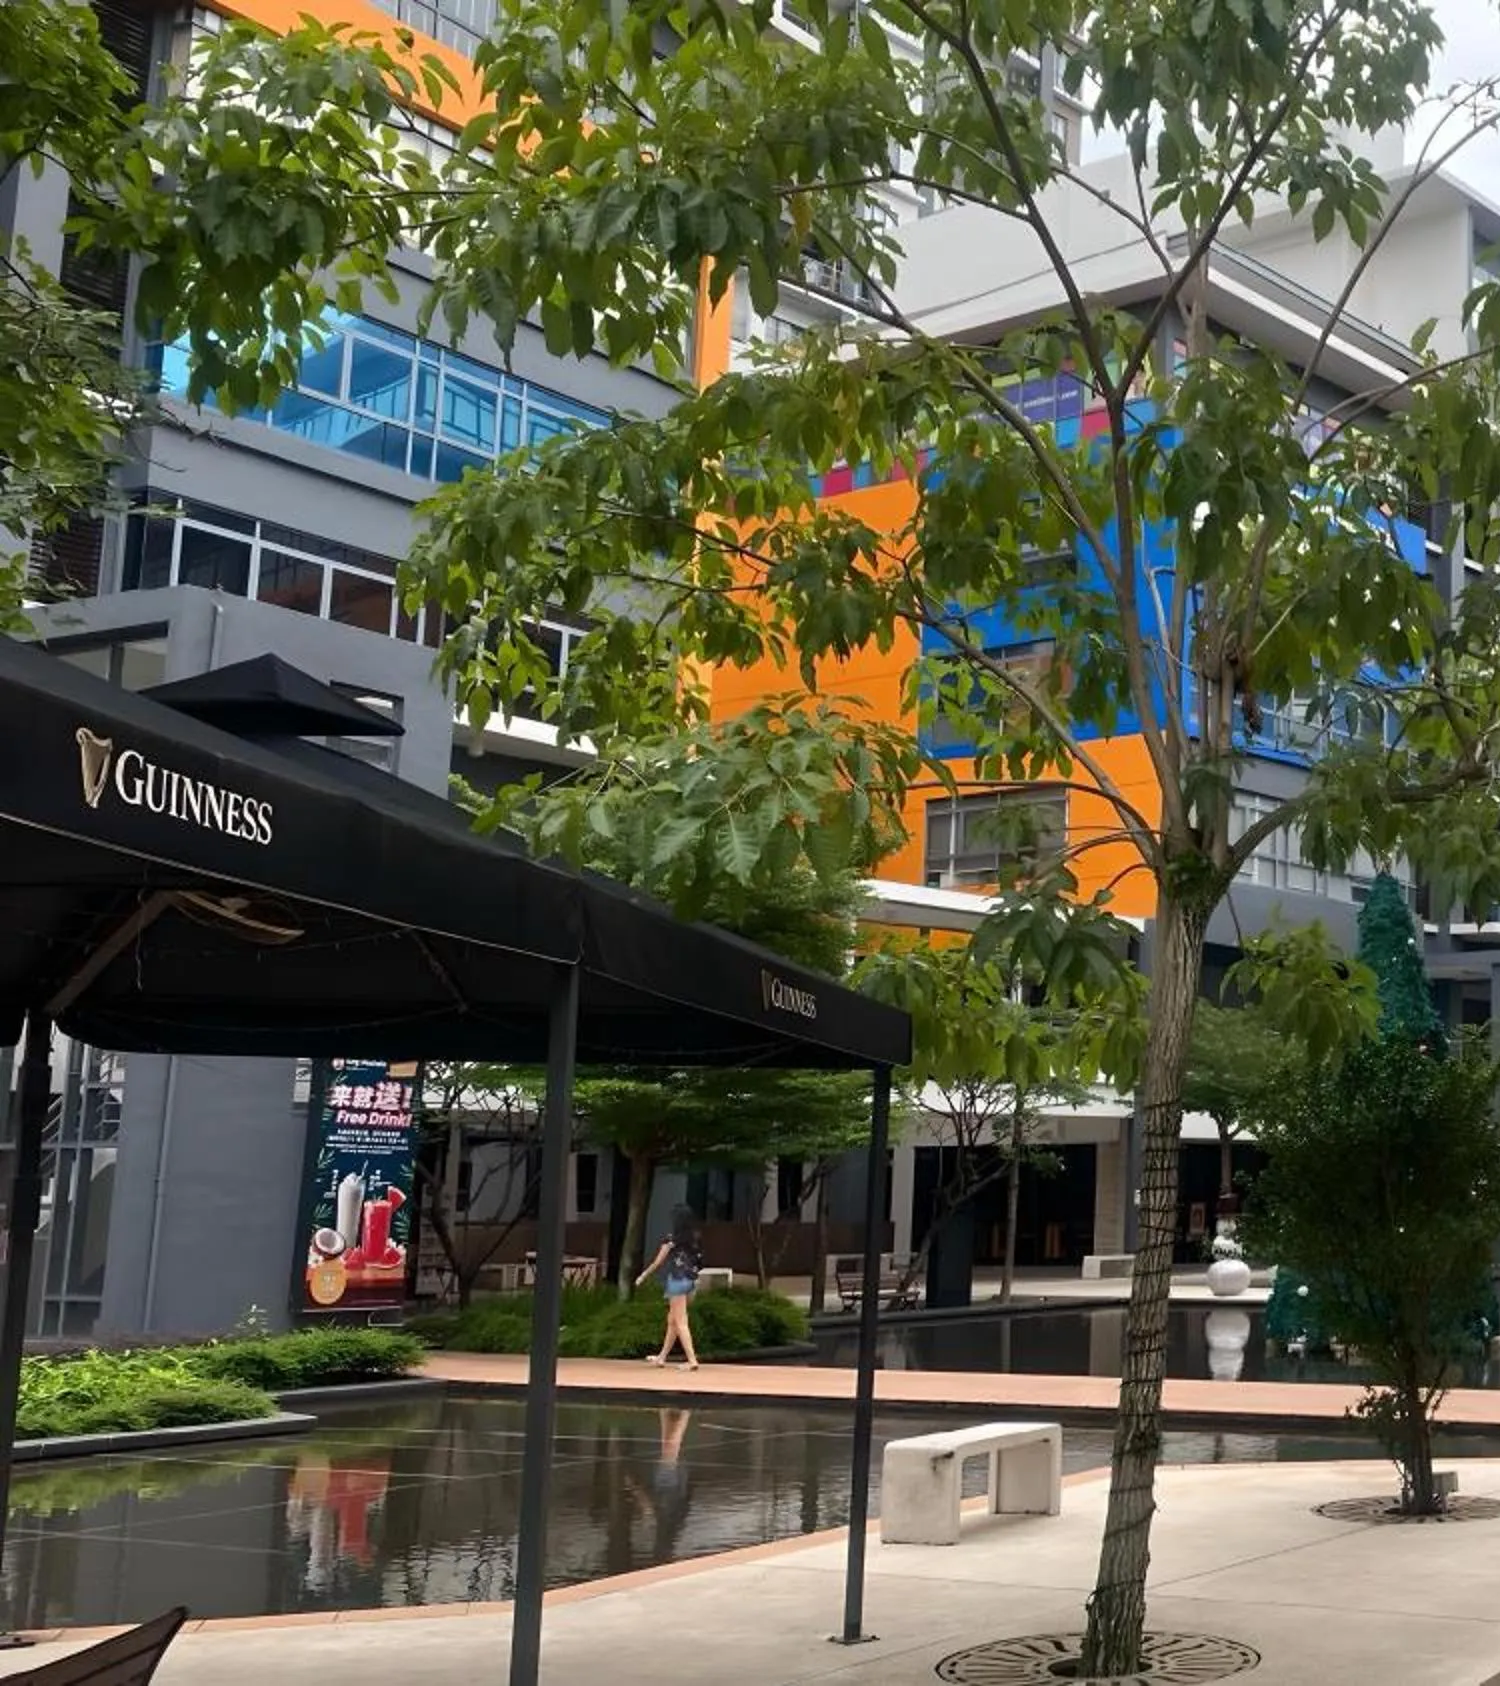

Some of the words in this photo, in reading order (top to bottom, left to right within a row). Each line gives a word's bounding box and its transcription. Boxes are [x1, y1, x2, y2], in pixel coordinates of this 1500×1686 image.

[114, 749, 274, 846] GUINNESS
[771, 977, 817, 1020] GUINNESS
[336, 1110, 368, 1124] Free
[368, 1111, 413, 1127] Drink!
